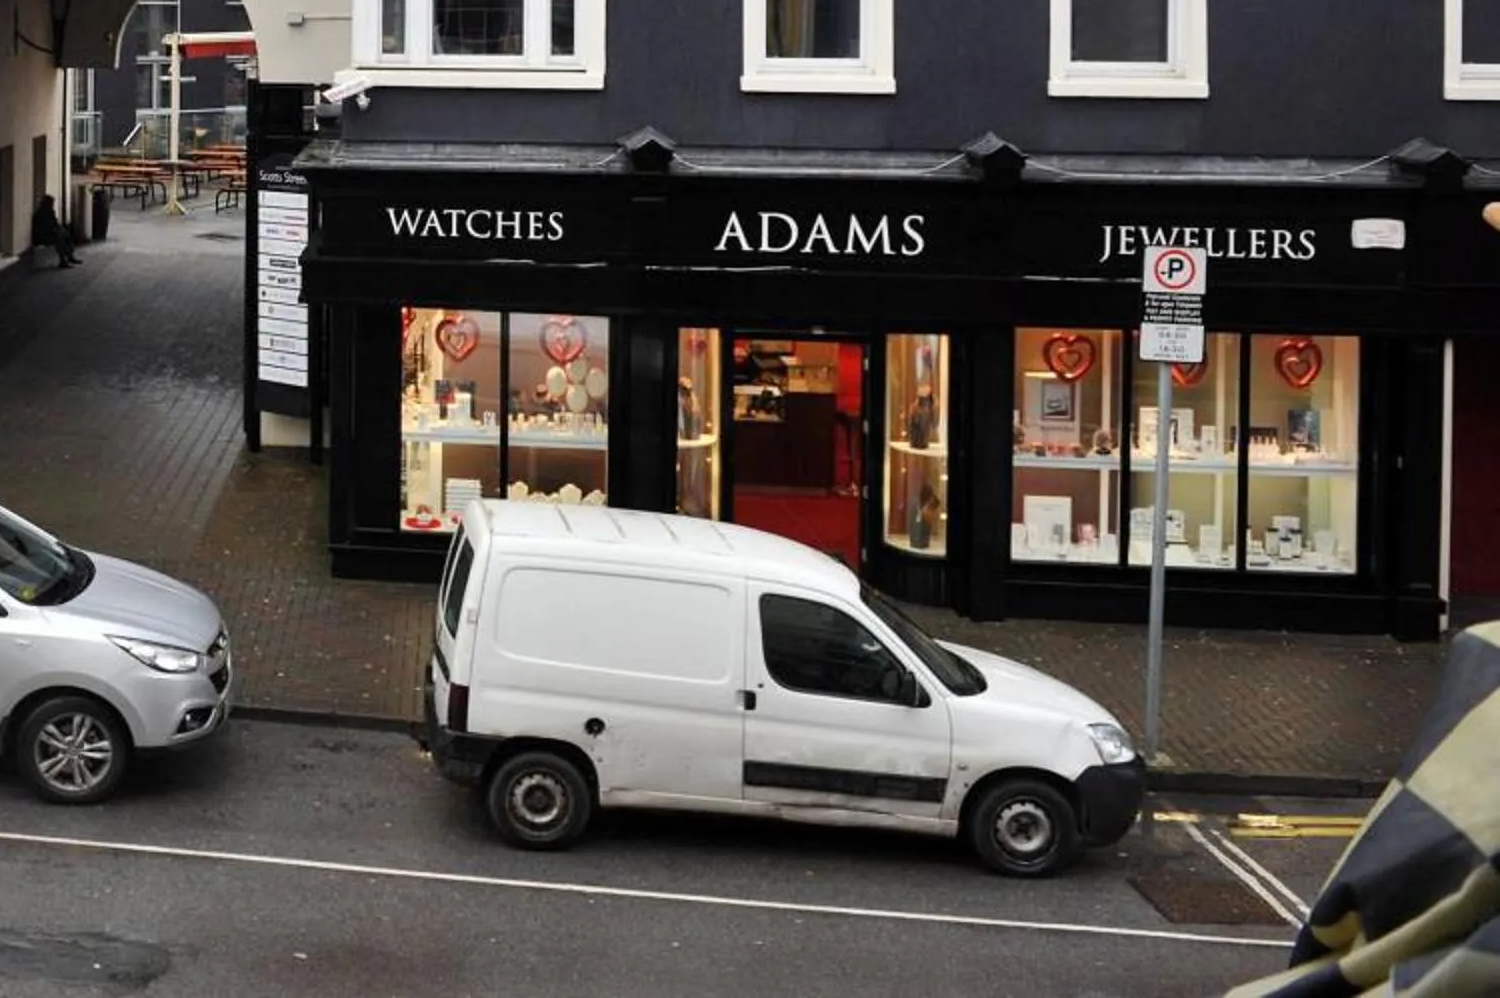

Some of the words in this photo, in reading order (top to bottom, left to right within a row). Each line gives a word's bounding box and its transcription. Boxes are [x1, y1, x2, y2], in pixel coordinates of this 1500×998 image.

[260, 169, 283, 183] Scotts
[386, 208, 564, 241] WATCHES
[714, 211, 926, 257] ADAMS
[1100, 225, 1316, 261] JEWELLERS
[1168, 258, 1184, 279] P
